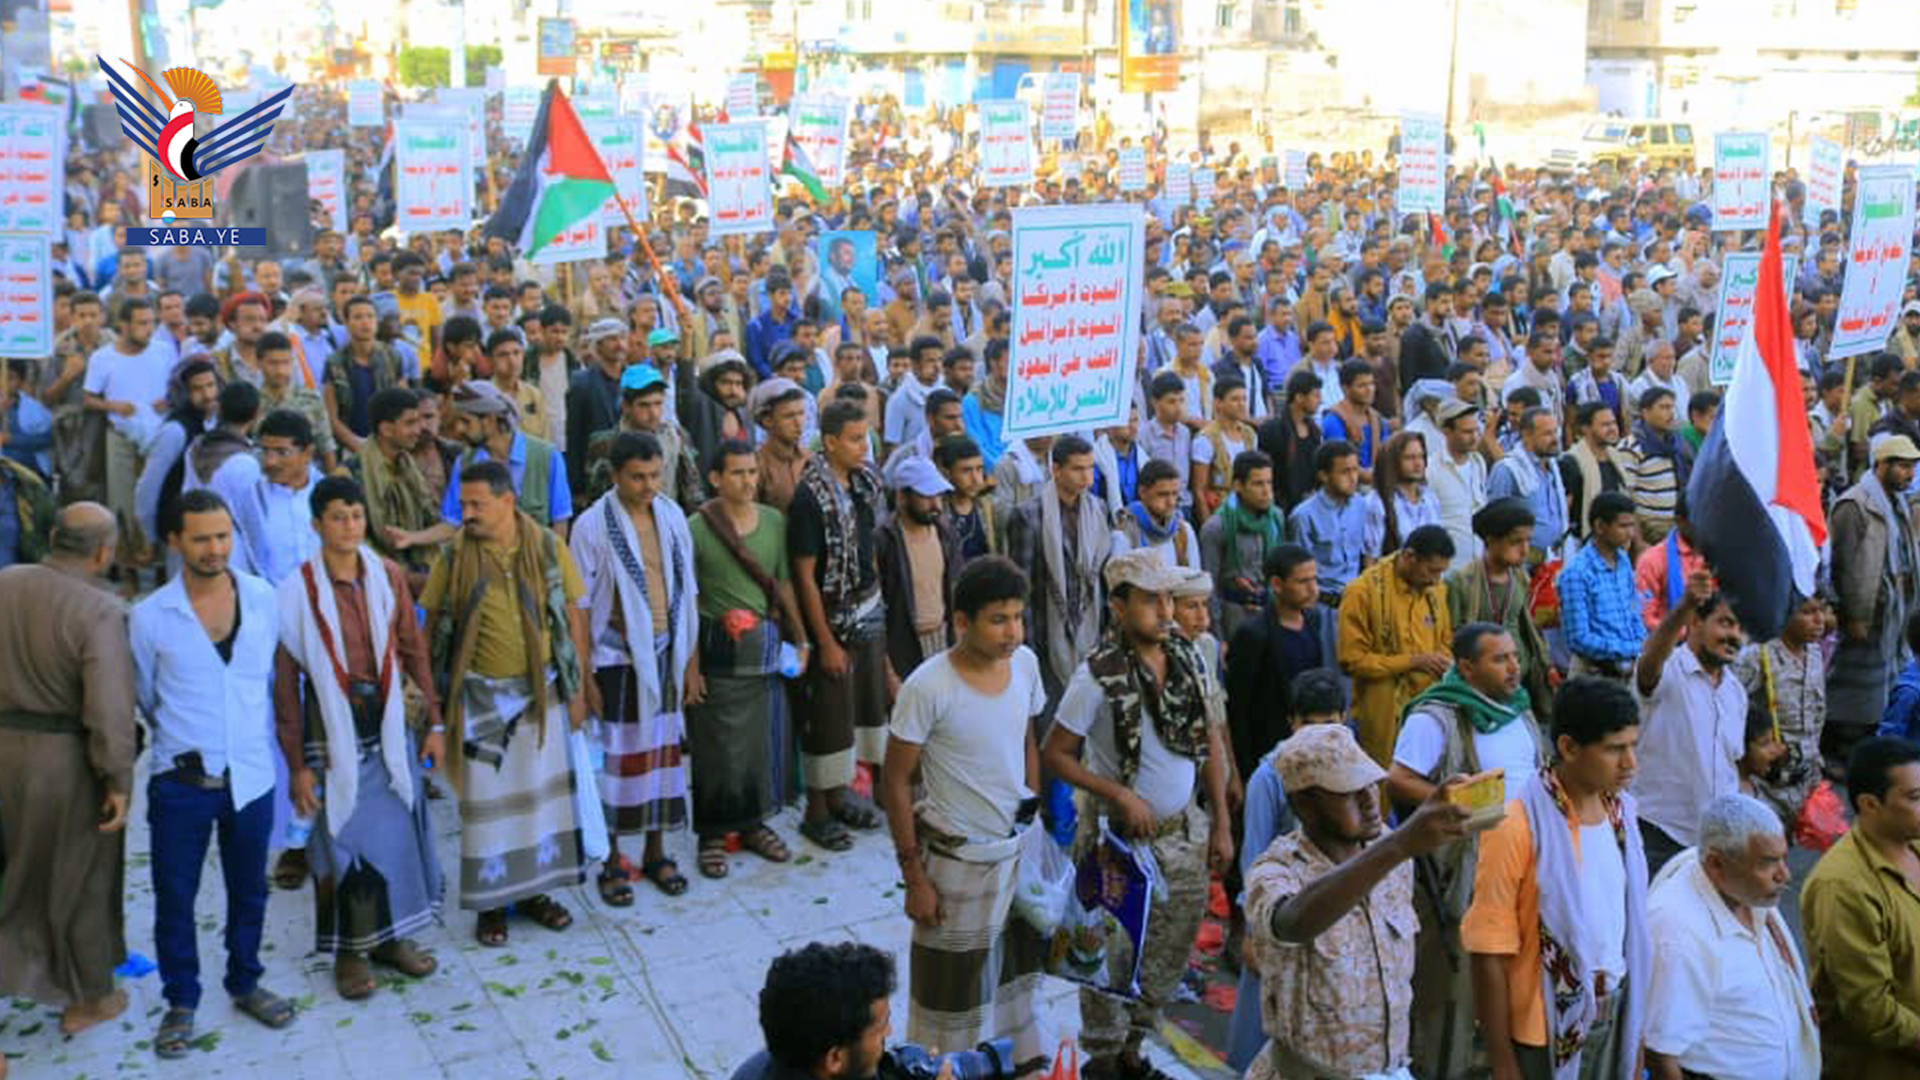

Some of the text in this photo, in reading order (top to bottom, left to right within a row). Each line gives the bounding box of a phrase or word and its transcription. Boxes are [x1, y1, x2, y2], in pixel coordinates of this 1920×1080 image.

[1088, 232, 1125, 264] الله
[1080, 278, 1125, 306] الموت
[1078, 314, 1122, 341] الموت
[1017, 353, 1058, 380] اليهود
[1069, 377, 1116, 416] النصر
